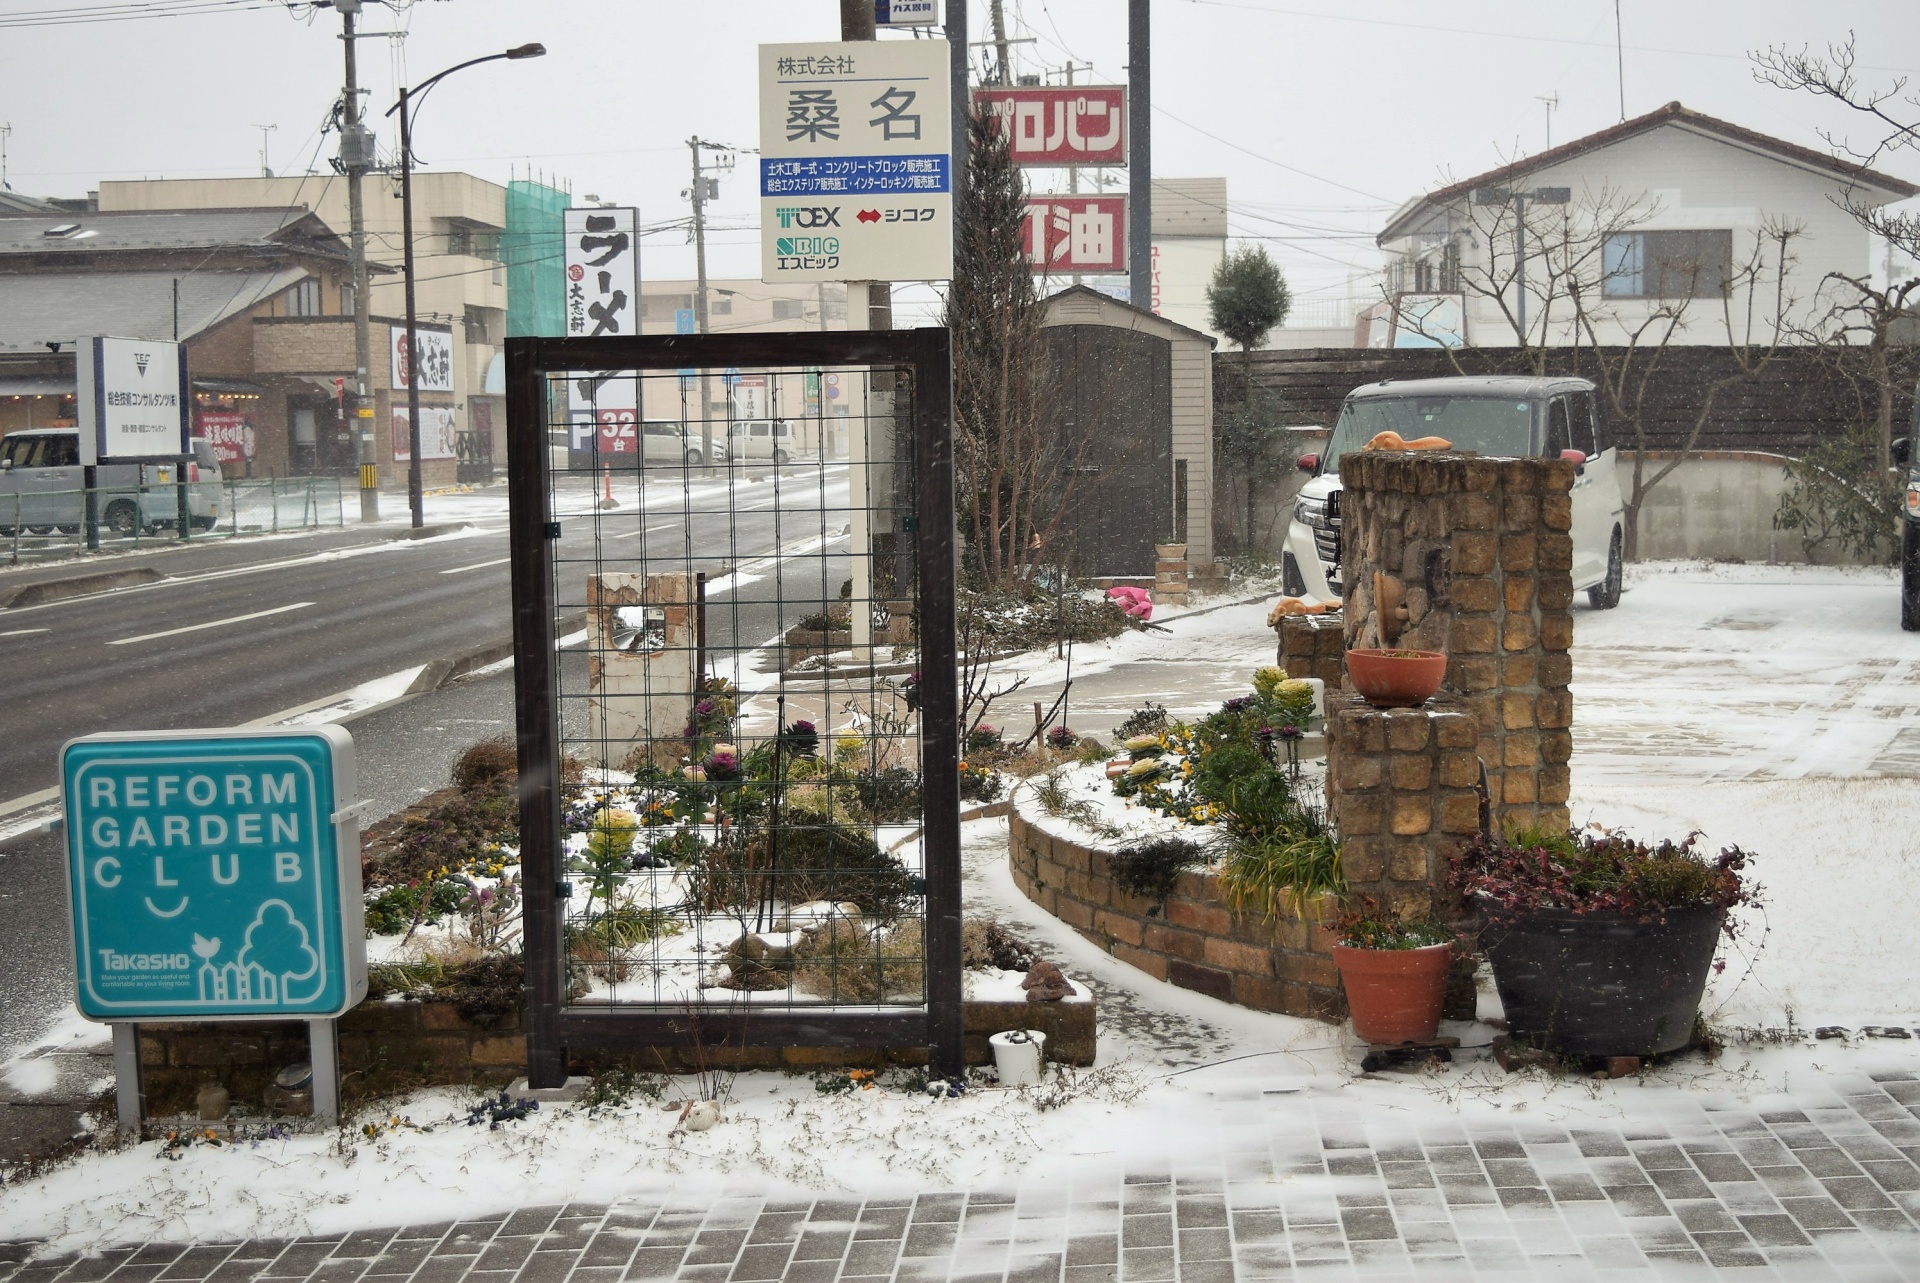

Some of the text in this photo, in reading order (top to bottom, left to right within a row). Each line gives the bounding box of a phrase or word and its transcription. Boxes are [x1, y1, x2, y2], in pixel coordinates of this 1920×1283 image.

[777, 55, 855, 76] 株式会社
[786, 87, 921, 142] 桑名
[977, 96, 1120, 152] プロパン
[776, 206, 841, 228] TOEX
[885, 208, 935, 222] シコク
[776, 237, 839, 255] SBIC
[777, 255, 839, 270] エスビック
[568, 283, 585, 333] 大志軒
[134, 353, 150, 362] TEC
[572, 413, 596, 450] P
[602, 412, 635, 438] 32
[613, 438, 626, 452] 台
[90, 772, 297, 808] REFORM
[91, 812, 300, 848] GARDEN
[93, 851, 303, 888] CLUB
